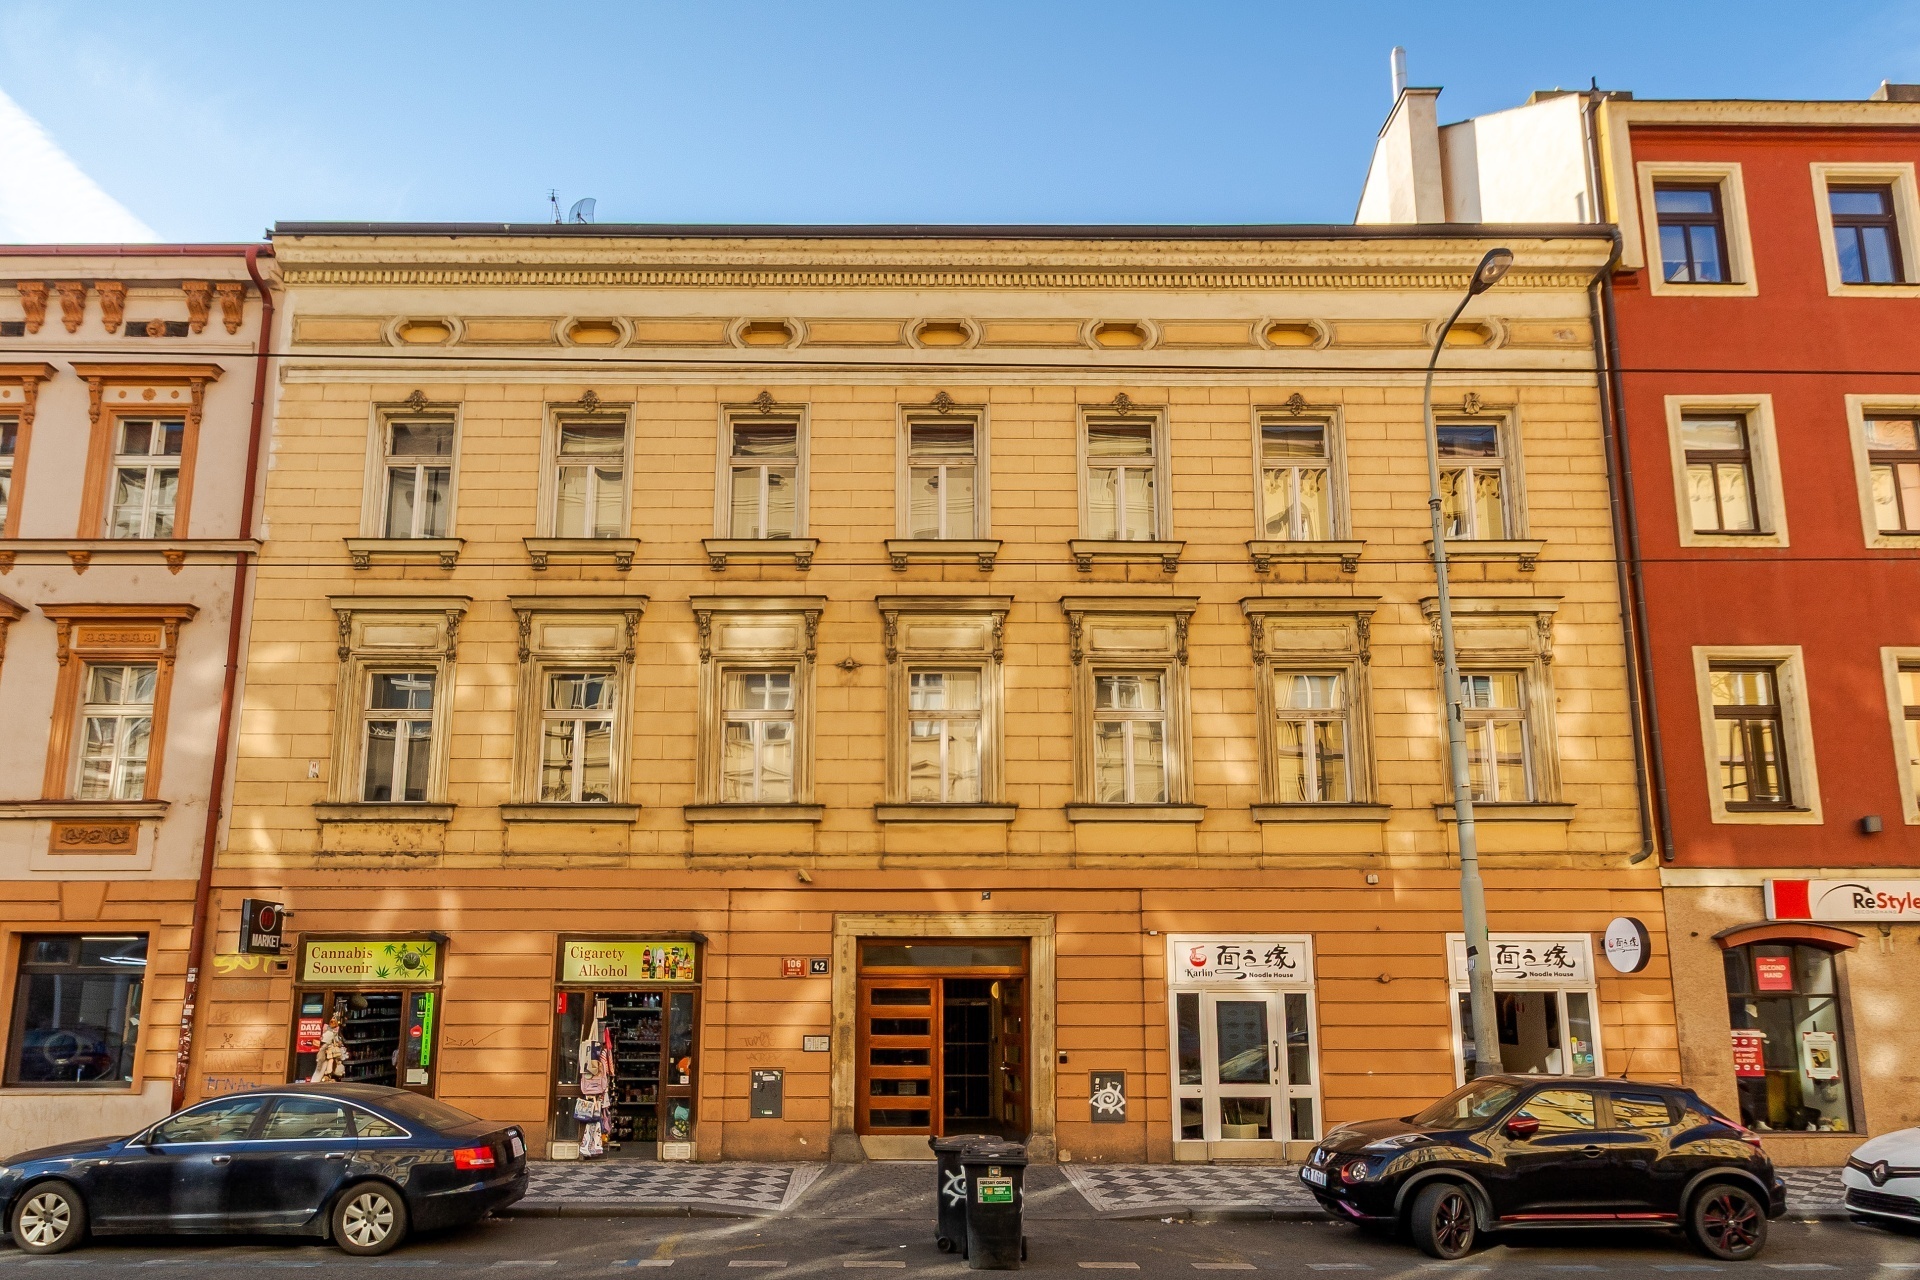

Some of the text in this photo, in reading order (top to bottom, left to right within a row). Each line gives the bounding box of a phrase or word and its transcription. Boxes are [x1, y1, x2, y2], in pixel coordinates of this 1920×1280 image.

[1853, 891, 1920, 914] ReStyle
[251, 933, 281, 948] MARKET
[311, 946, 373, 959] Cannabis
[570, 946, 625, 962] Cigarety
[312, 961, 373, 974] Souvenir
[578, 964, 628, 977] Alkohol
[787, 960, 801, 968] 106
[814, 962, 826, 971] 42
[300, 1023, 322, 1031] DATA
